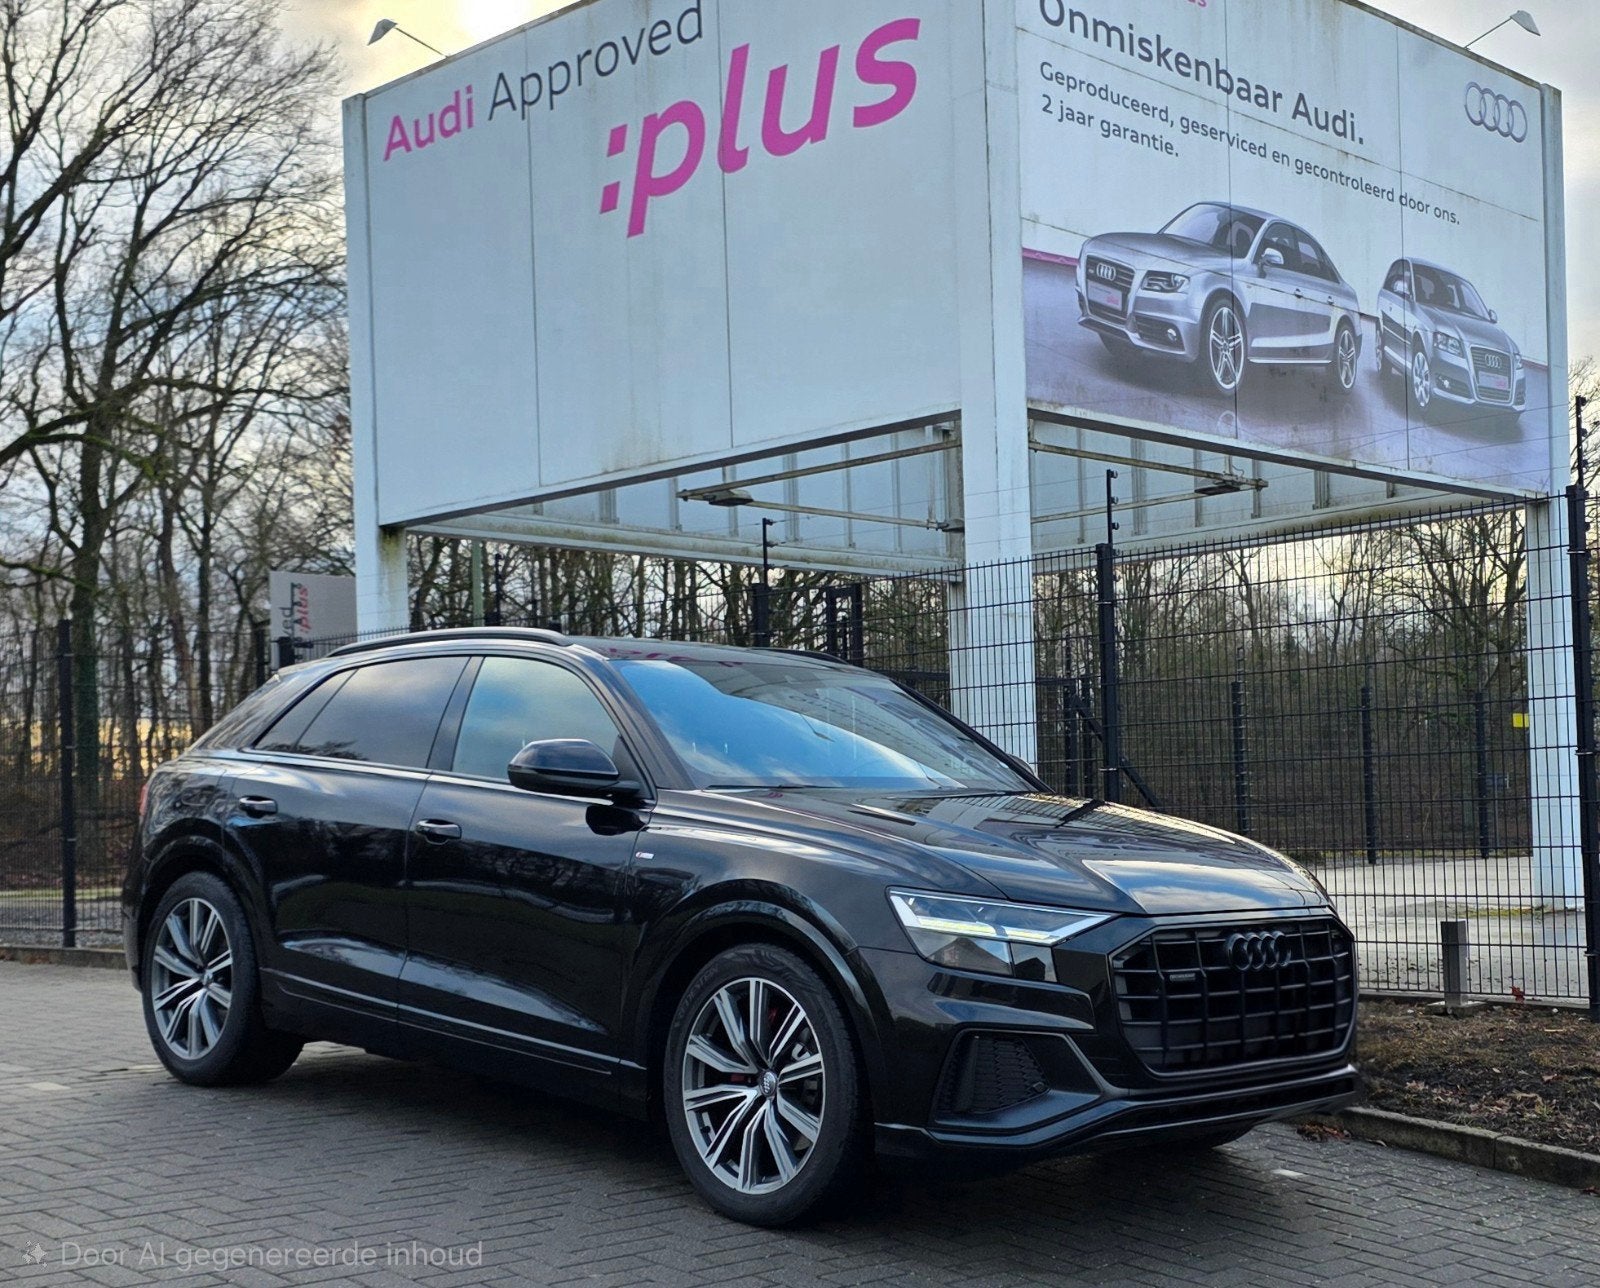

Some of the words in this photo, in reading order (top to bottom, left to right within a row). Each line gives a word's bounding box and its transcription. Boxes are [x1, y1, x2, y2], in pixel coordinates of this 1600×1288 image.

[383, 85, 474, 162] Audi
[488, 0, 704, 120] Approved
[1040, 0, 1283, 112] Onmiskenbaar
[1291, 91, 1364, 144] Audi.
[1040, 62, 1174, 128] Geproduceerd,
[1180, 115, 1267, 160] geserviced
[1272, 152, 1290, 166] en
[1294, 155, 1394, 204] gecontroleerd
[1399, 195, 1430, 214] door
[1433, 205, 1460, 225] ons.
[1042, 94, 1053, 113] 2
[1057, 100, 1094, 128] jaar
[1100, 116, 1179, 157] garantie.
